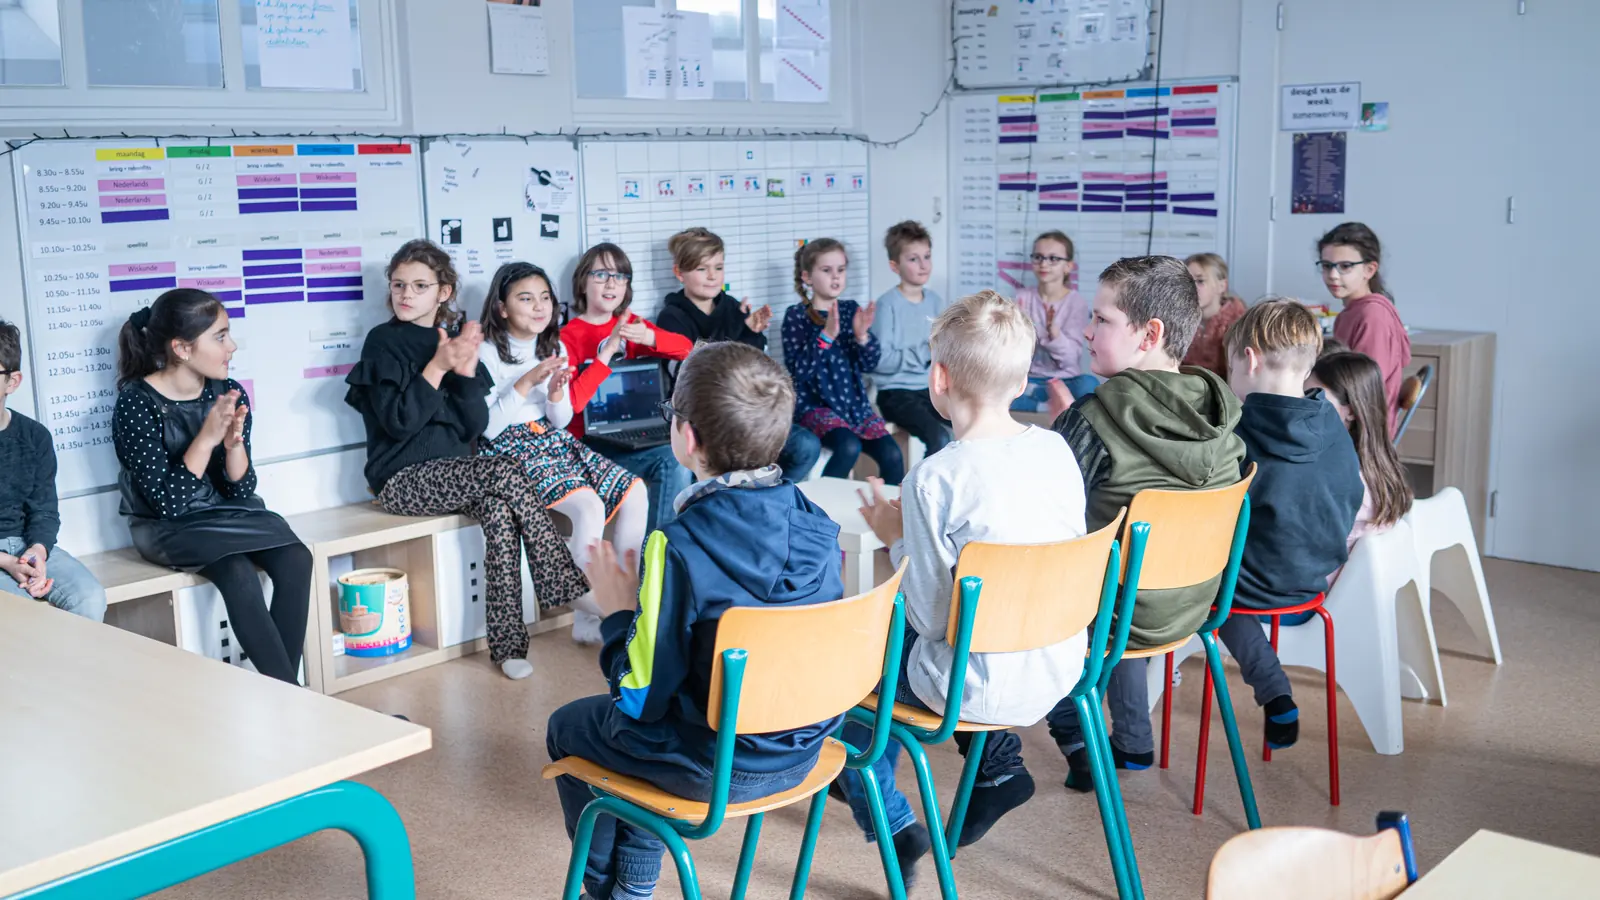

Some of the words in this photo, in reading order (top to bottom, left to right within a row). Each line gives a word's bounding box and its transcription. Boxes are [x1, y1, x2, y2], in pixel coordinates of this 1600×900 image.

[1290, 87, 1318, 96] deugd
[116, 150, 146, 158] maandag
[37, 169, 57, 177] 8.30u
[39, 185, 59, 193] 8.55u
[40, 201, 60, 209] 9.20u
[45, 290, 69, 298] 10.50u
[48, 352, 74, 360] 12.05u
[84, 348, 111, 357] 12.30u
[49, 367, 76, 376] 12.30u
[85, 363, 112, 372] 13.20u
[50, 394, 78, 404] 13.20u
[87, 390, 113, 399] 13.45u
[53, 411, 80, 420] 13.45u
[54, 426, 81, 436] 14.10u
[90, 420, 112, 430] 14.35
[56, 441, 82, 451] 14.35u
[92, 436, 113, 446] 15.00
